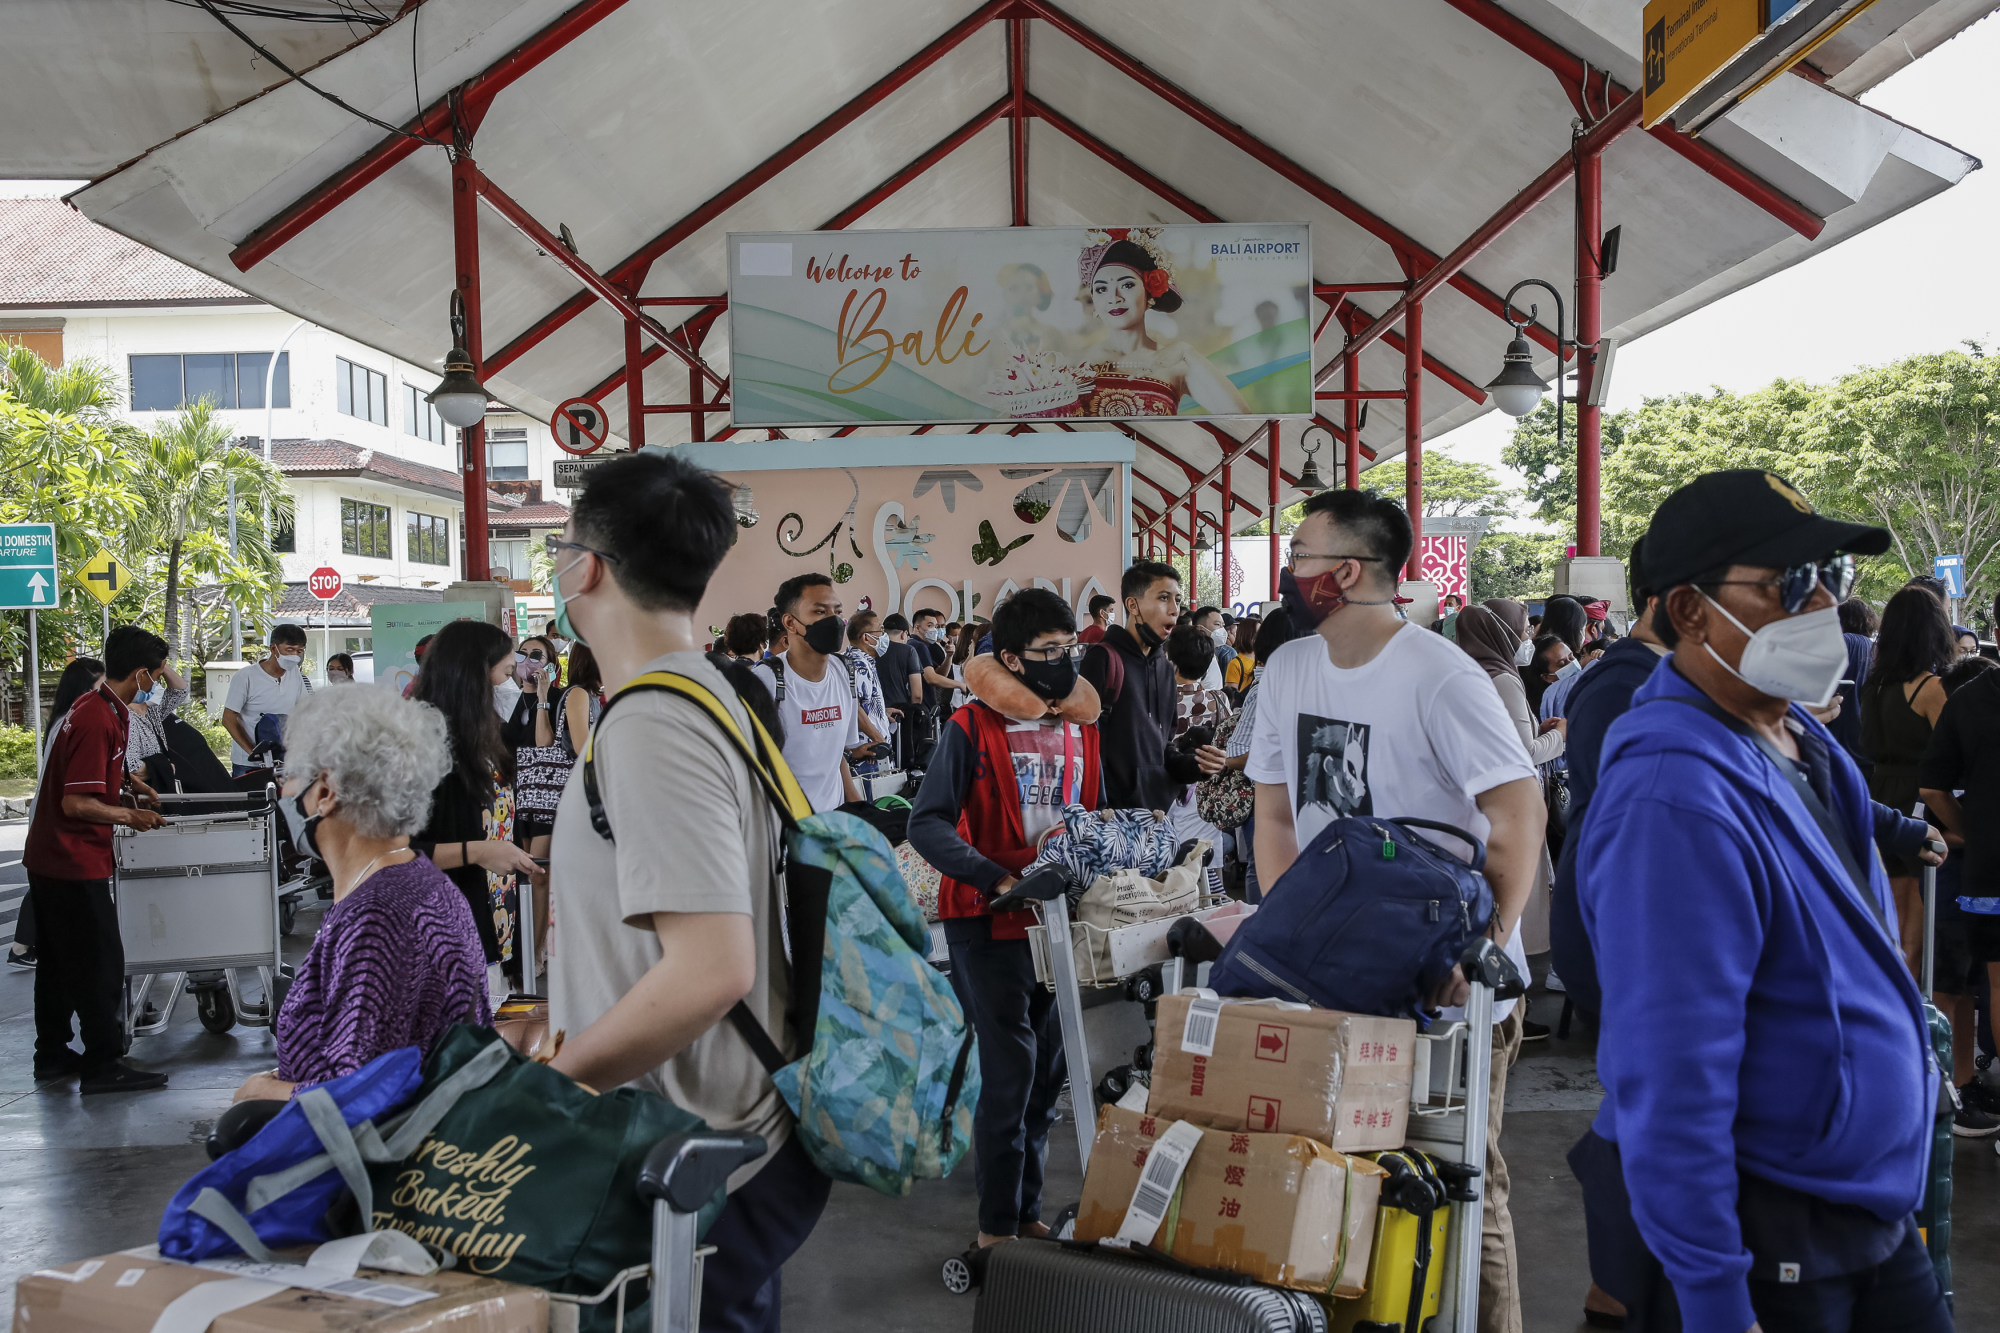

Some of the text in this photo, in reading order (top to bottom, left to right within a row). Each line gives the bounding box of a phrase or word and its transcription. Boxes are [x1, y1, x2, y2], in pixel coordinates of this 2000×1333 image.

[1666, 4, 1691, 40] Terminal
[1666, 7, 1719, 64] International Terminal
[806, 252, 922, 284] Welcome to
[1211, 242, 1300, 255] BALI AIRPORT
[827, 285, 991, 394] Bali
[5, 534, 52, 547] DOMESTIK
[311, 575, 340, 590] STOP
[1190, 1055, 1207, 1097] 6 BOTOL
[412, 1134, 537, 1197] reshly
[392, 1169, 513, 1226] Baked,
[452, 1221, 527, 1274] day
